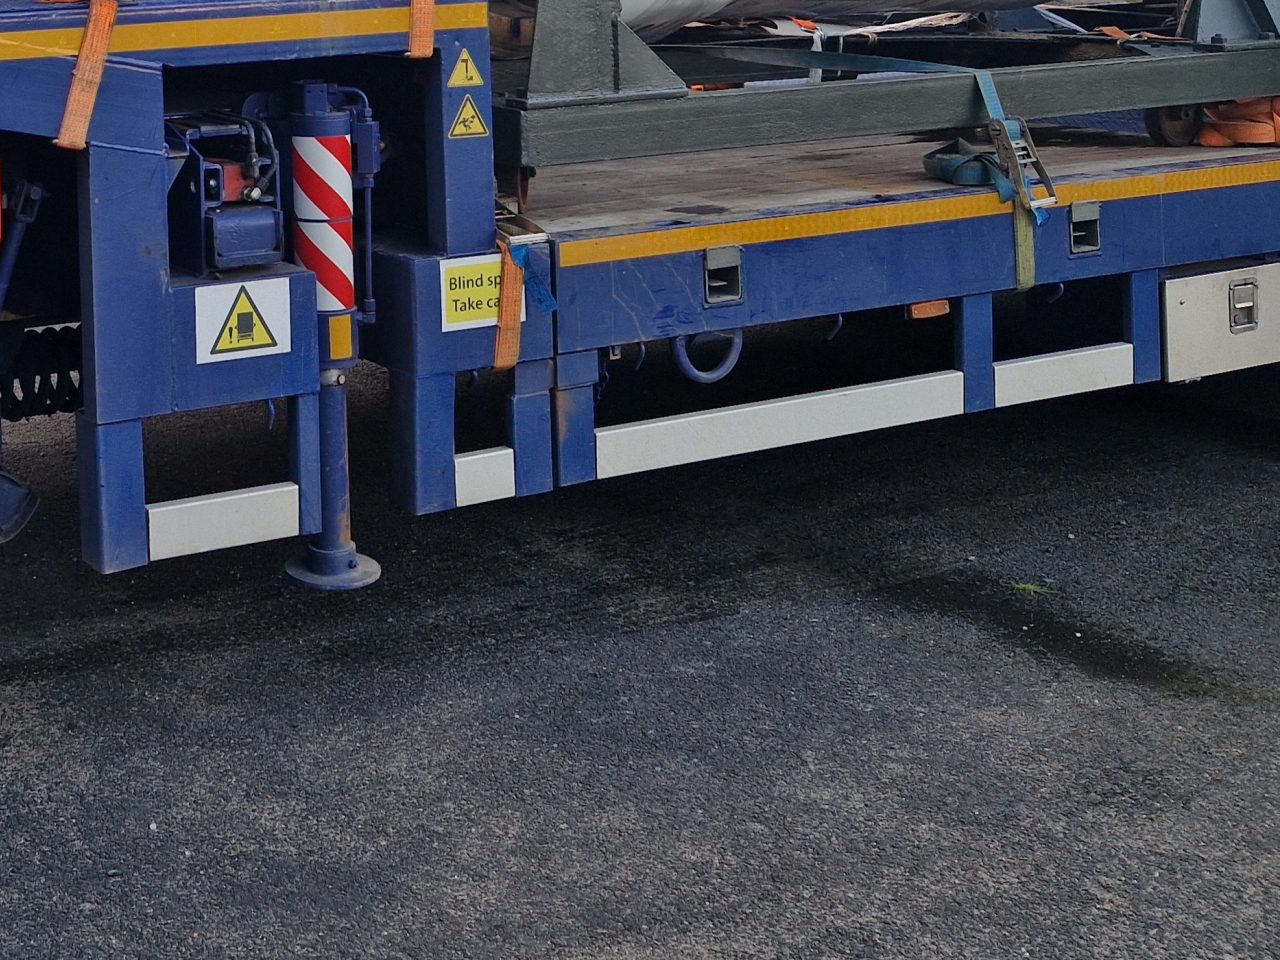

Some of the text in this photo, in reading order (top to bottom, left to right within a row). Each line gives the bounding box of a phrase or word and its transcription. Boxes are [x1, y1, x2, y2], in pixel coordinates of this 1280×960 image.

[449, 273, 502, 291] Blind sp
[452, 296, 500, 312] Take ca
